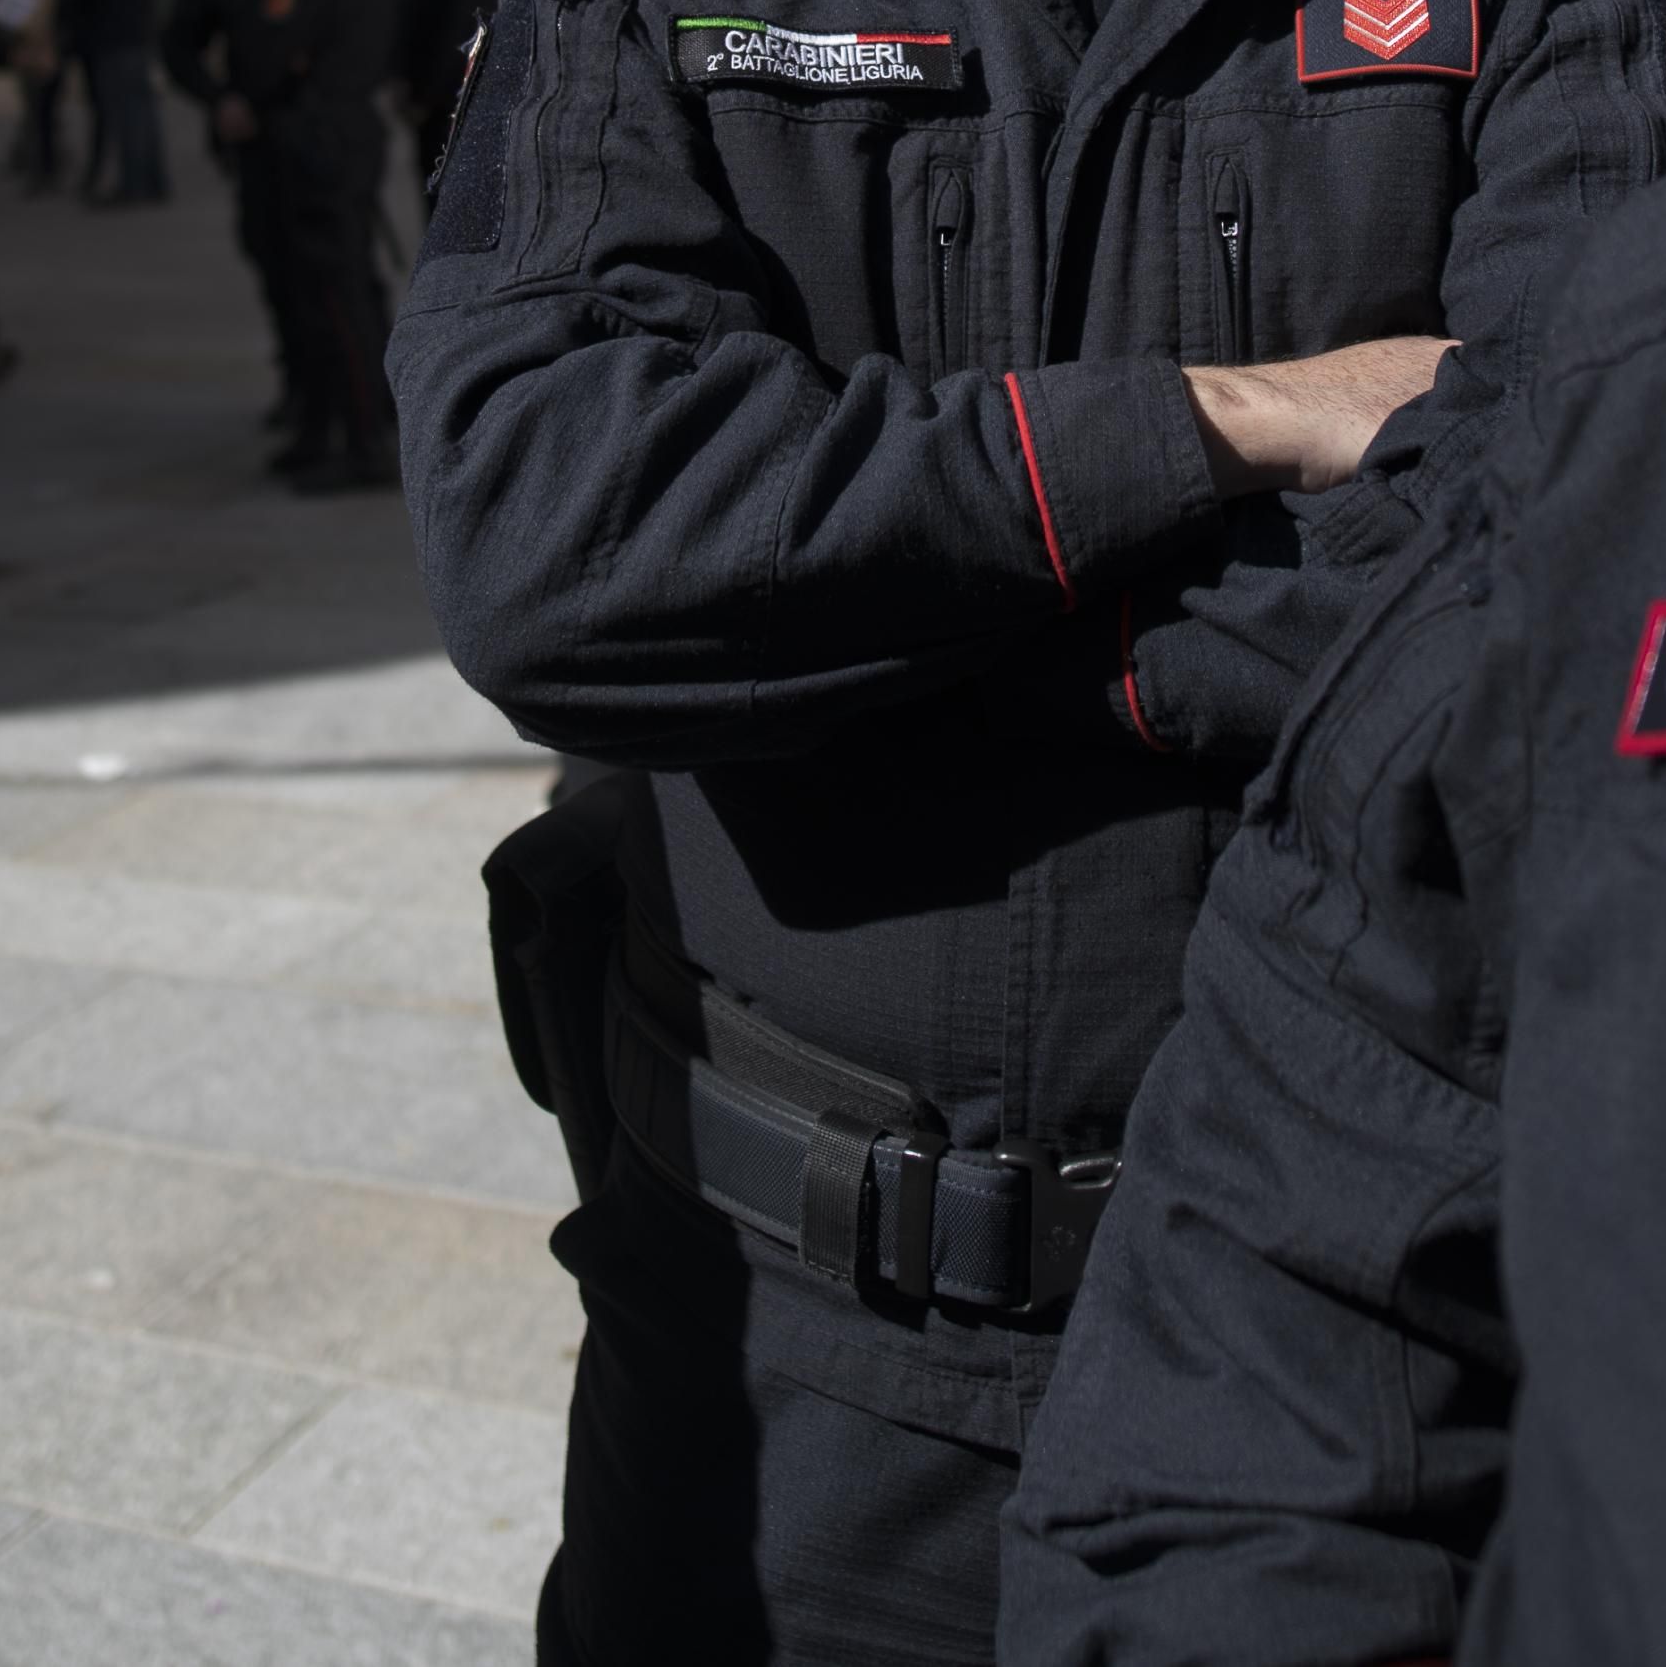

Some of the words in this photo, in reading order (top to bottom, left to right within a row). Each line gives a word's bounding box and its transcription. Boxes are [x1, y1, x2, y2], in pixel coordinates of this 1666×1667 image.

[724, 30, 904, 69] CARABINIERI
[731, 54, 849, 84] BATTAGLIONE
[850, 64, 924, 82] LIGURIA
